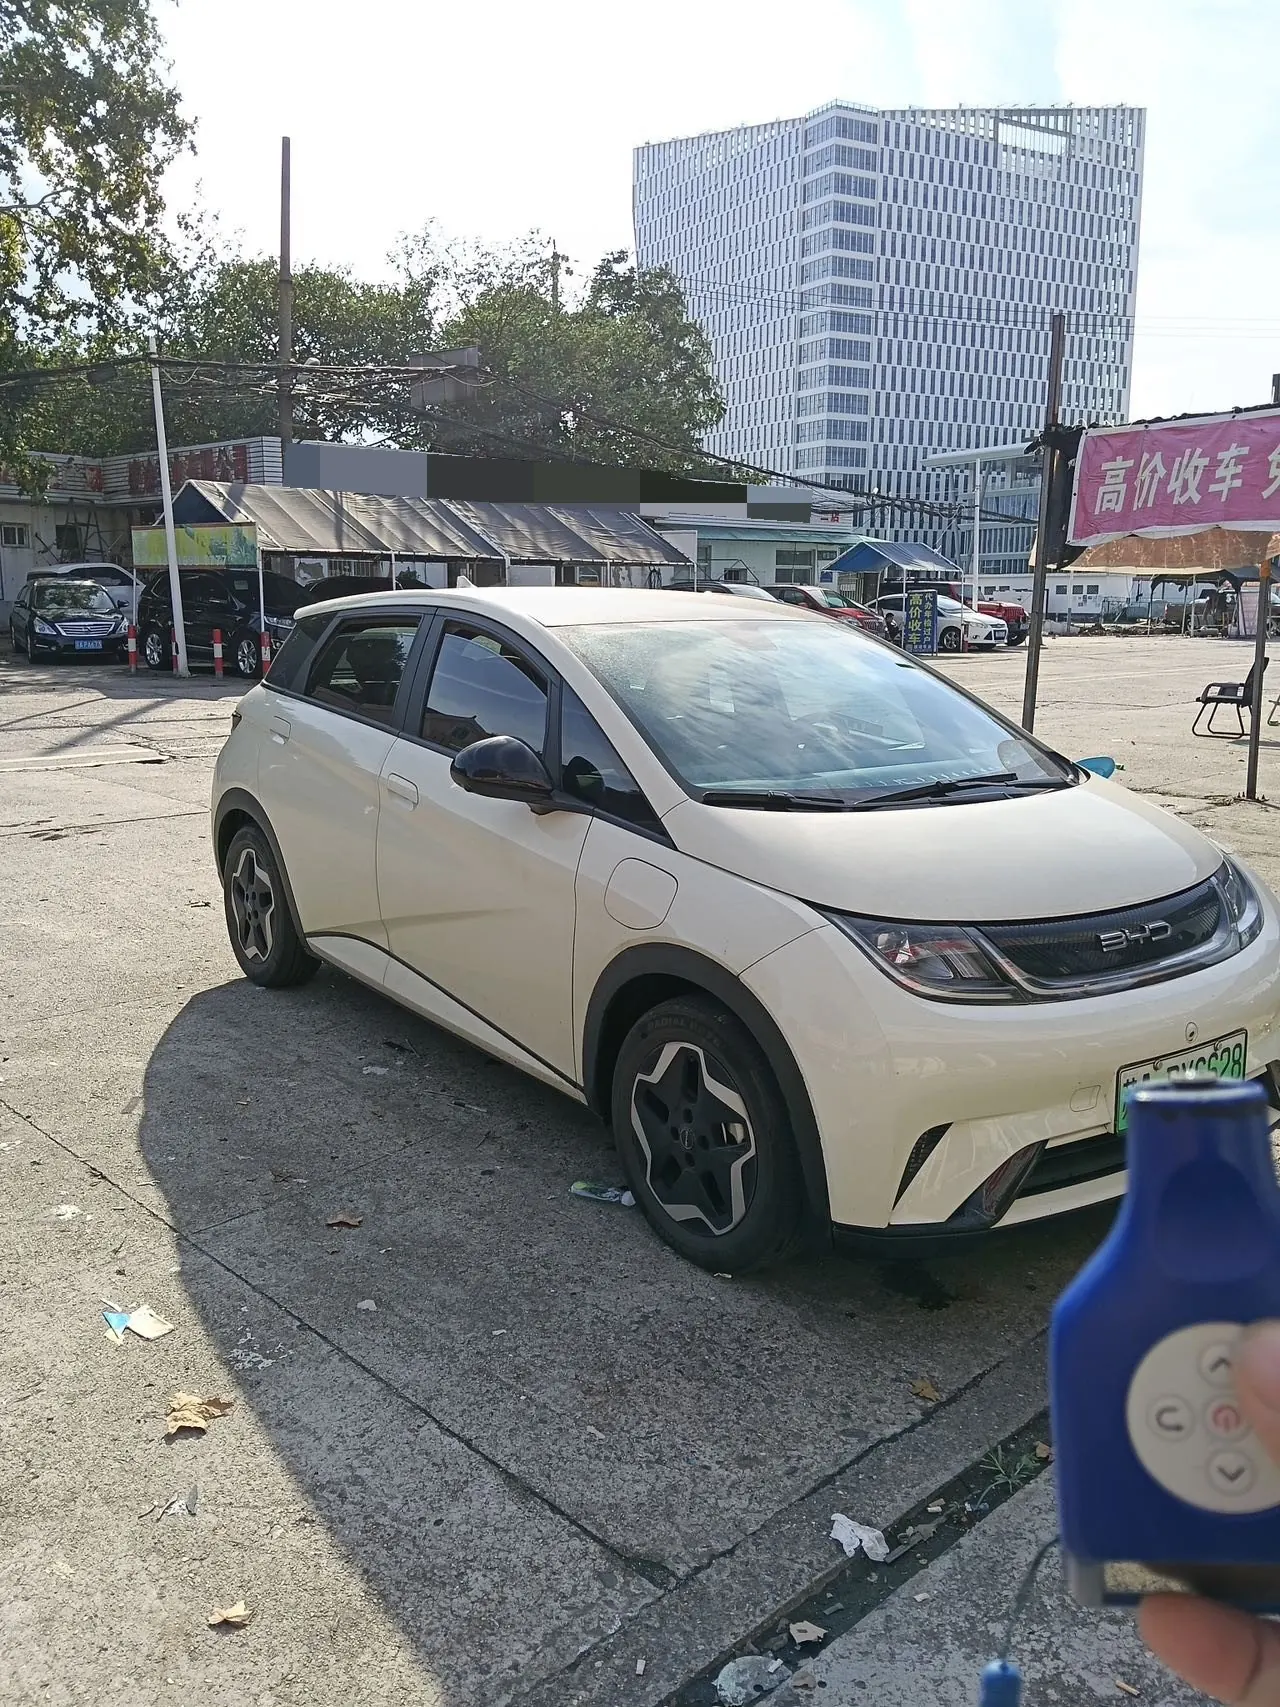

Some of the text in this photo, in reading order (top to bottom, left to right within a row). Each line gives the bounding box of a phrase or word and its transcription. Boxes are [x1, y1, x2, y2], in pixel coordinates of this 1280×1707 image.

[1094, 442, 1250, 515] 高价收车
[908, 593, 923, 645] 高价收车
[1096, 920, 1172, 952] BYD
